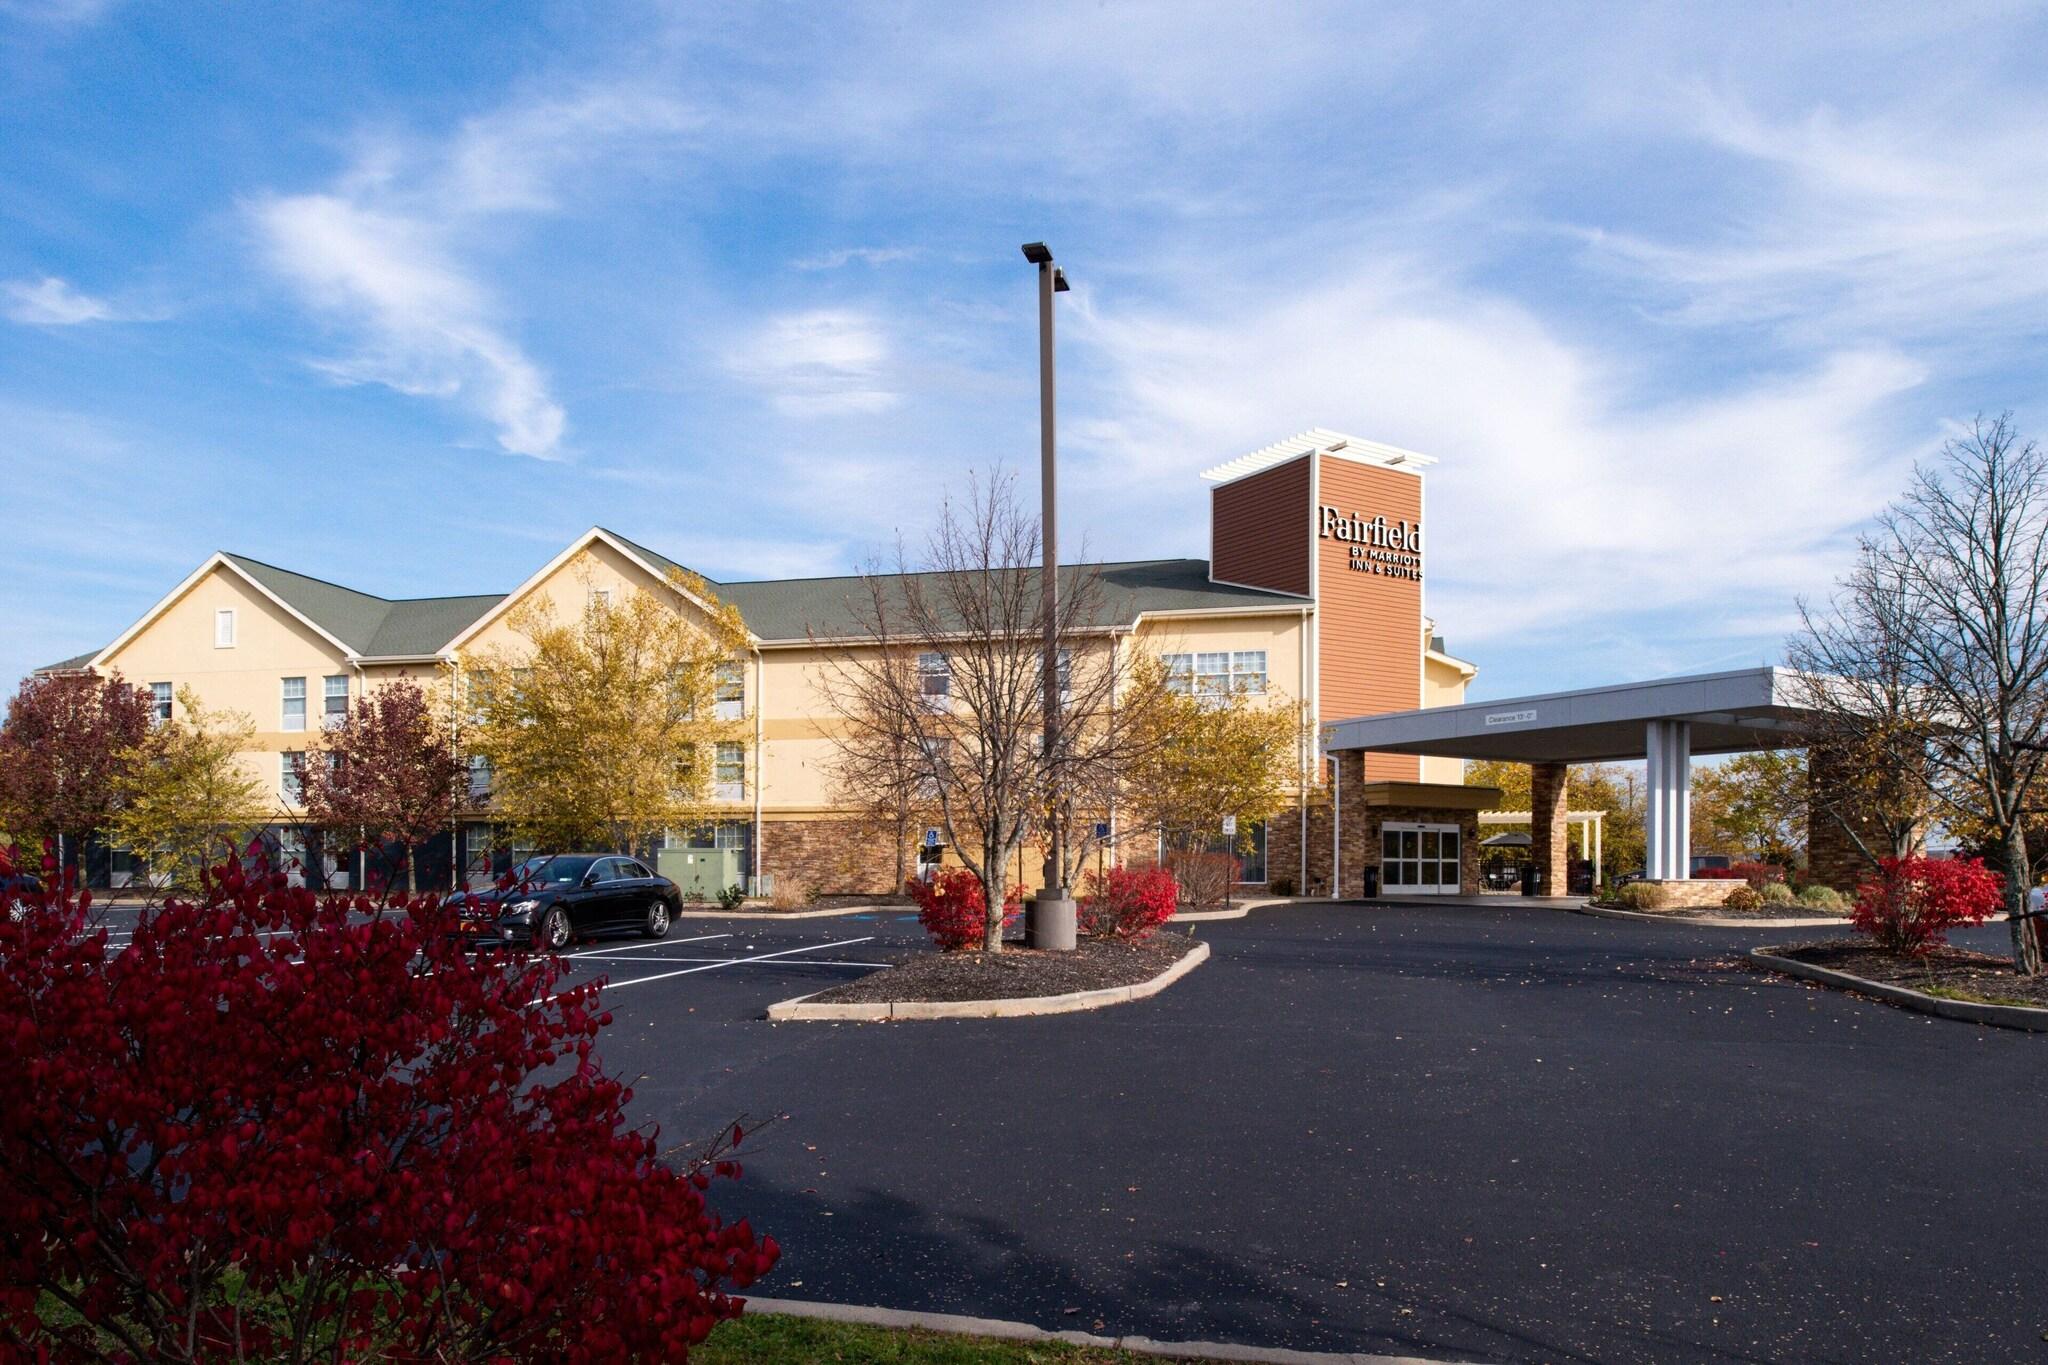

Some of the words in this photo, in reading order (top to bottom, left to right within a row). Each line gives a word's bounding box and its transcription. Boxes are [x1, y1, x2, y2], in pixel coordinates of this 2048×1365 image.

[1320, 505, 1424, 554] Fairfield
[1352, 546, 1366, 557] BY
[1352, 559, 1371, 571] INN
[1375, 563, 1382, 573] &
[1387, 565, 1424, 580] SUITES
